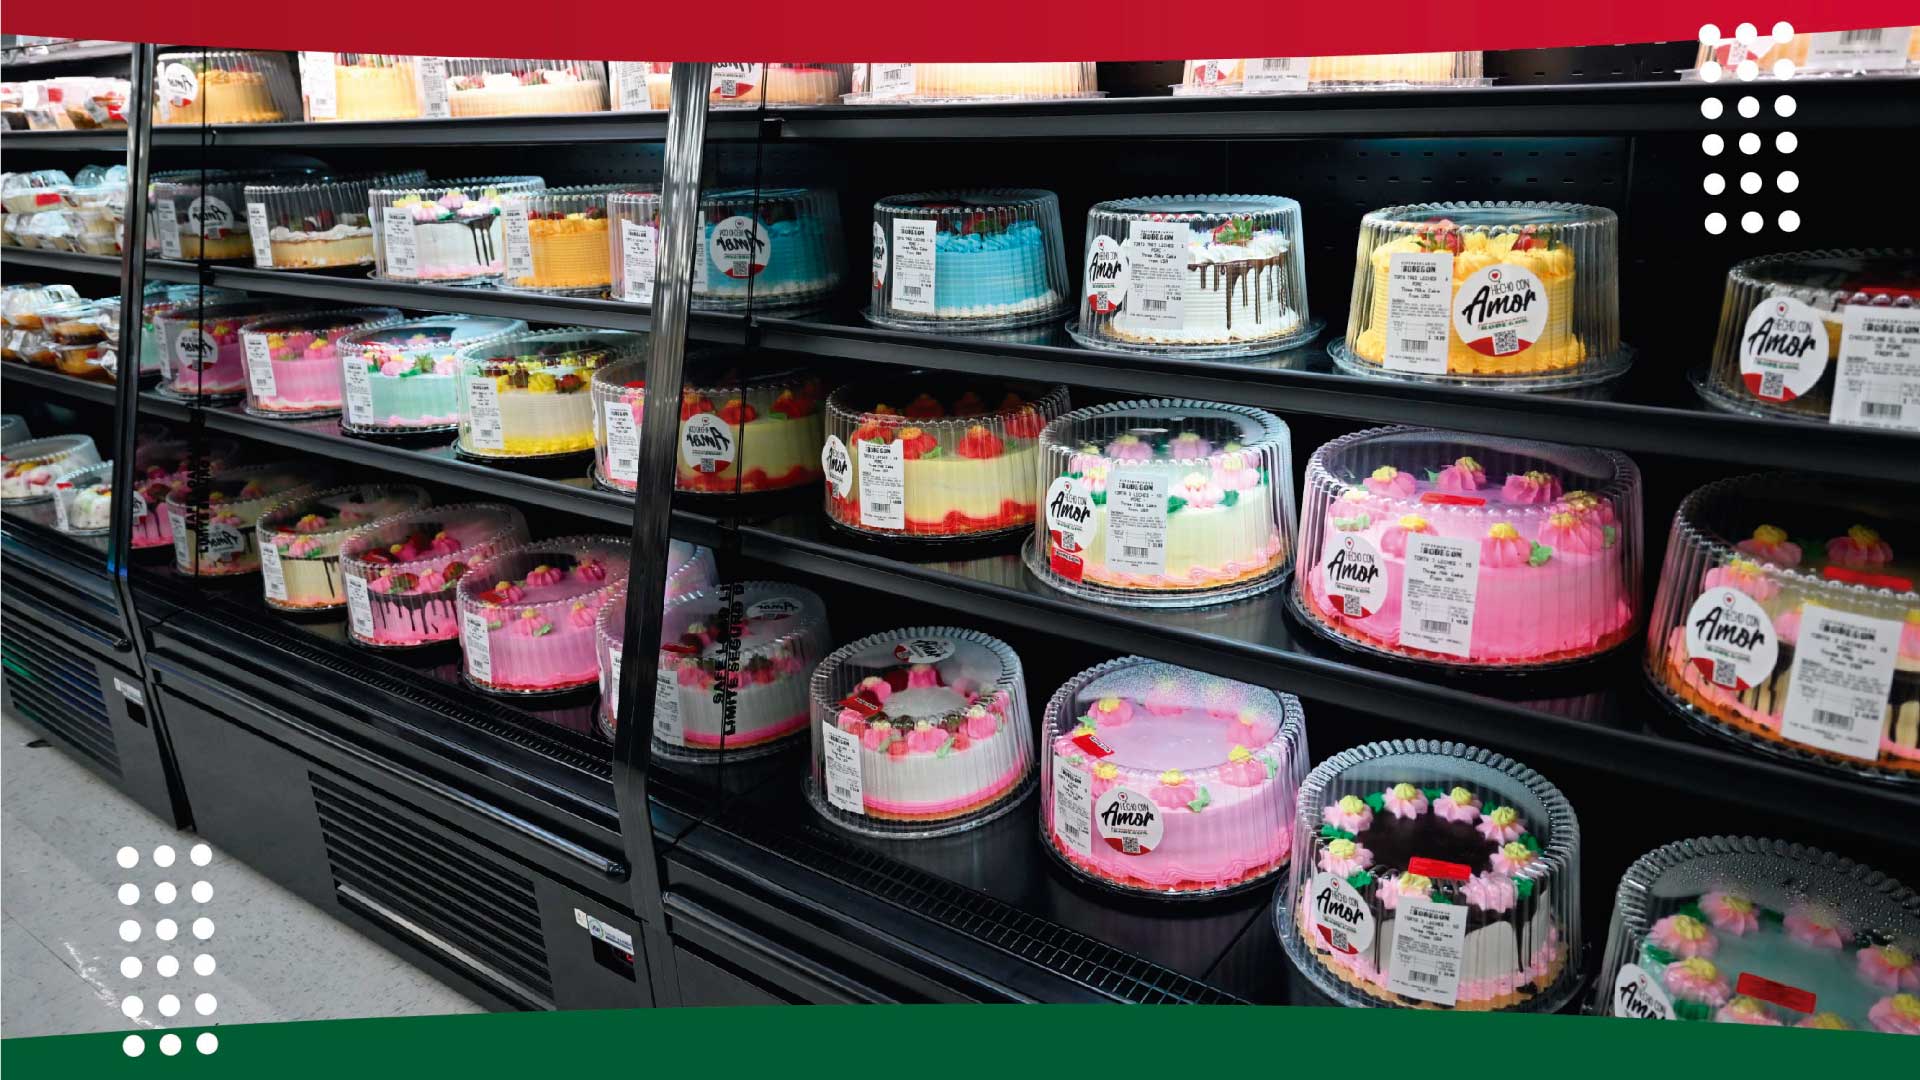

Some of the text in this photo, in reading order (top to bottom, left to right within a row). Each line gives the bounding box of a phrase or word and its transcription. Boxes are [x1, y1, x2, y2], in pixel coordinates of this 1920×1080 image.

[1089, 252, 1122, 283] Amor
[1491, 278, 1530, 295] HECHO CON
[1462, 285, 1537, 326] Amor
[1748, 317, 1817, 358] Amor
[1050, 490, 1091, 524] Amor
[1328, 549, 1379, 584] Amor
[1364, 554, 1374, 564] CON
[1696, 606, 1765, 650] Amor
[1746, 614, 1760, 628] CON
[1101, 802, 1154, 827] Amor
[1138, 803, 1150, 812] CON
[1317, 887, 1364, 924] Amor
